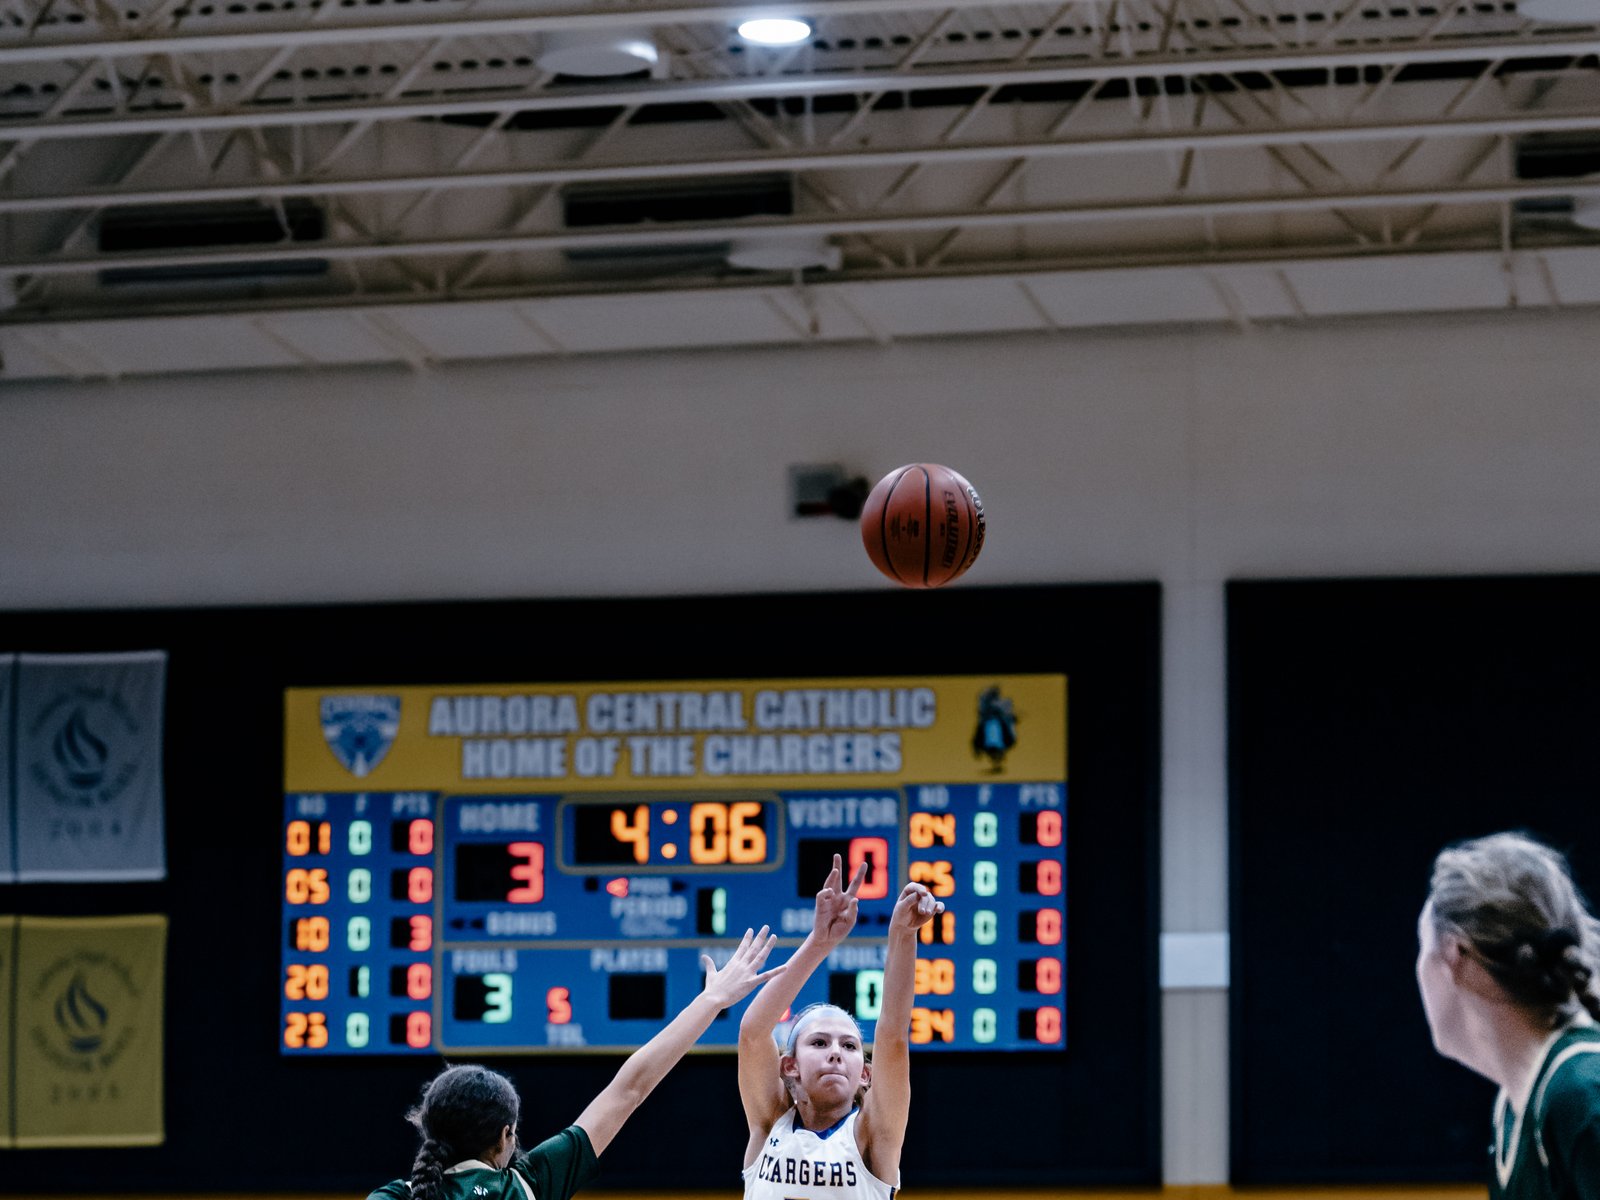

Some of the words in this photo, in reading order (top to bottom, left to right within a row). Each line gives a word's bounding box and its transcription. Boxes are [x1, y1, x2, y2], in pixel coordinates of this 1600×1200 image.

[431, 695, 579, 735] AURORA
[587, 691, 747, 732] CENTRAL
[755, 688, 936, 728] CATHOLIC
[462, 738, 567, 778] HOME
[574, 736, 621, 777] OF
[627, 735, 696, 776] THE
[704, 732, 902, 775] CHARGERS
[788, 797, 898, 828] VISITOR
[1019, 784, 1060, 806] PTS
[459, 804, 540, 831] HOME
[610, 802, 767, 865] 4:06
[973, 812, 998, 848] 0
[1036, 810, 1062, 847] 0
[287, 820, 331, 856] 01
[348, 820, 372, 856] 0
[408, 819, 434, 855] 0
[286, 868, 330, 904] 05
[348, 868, 371, 903] 0
[408, 867, 433, 903] 0
[507, 841, 544, 904] 3
[848, 836, 889, 899] 0
[973, 861, 997, 897] 0
[1036, 859, 1062, 896] 0
[487, 912, 556, 935] BONUS
[610, 894, 688, 919] PERIOD
[711, 887, 727, 935] 1
[347, 916, 371, 952] 0
[408, 914, 433, 951] 3
[973, 910, 997, 946] 0
[1036, 908, 1062, 946] 0
[451, 948, 518, 972] FOULS
[590, 948, 669, 971] PLAYER
[973, 958, 997, 995] 0
[1036, 957, 1062, 994] 0
[285, 964, 330, 1000] 20
[356, 965, 370, 998] 1
[407, 963, 432, 1000] 0
[482, 973, 513, 1024] 3
[345, 1012, 370, 1048] 0
[406, 1011, 432, 1048] 0
[973, 1007, 997, 1044] 0
[1036, 1006, 1062, 1044] 0
